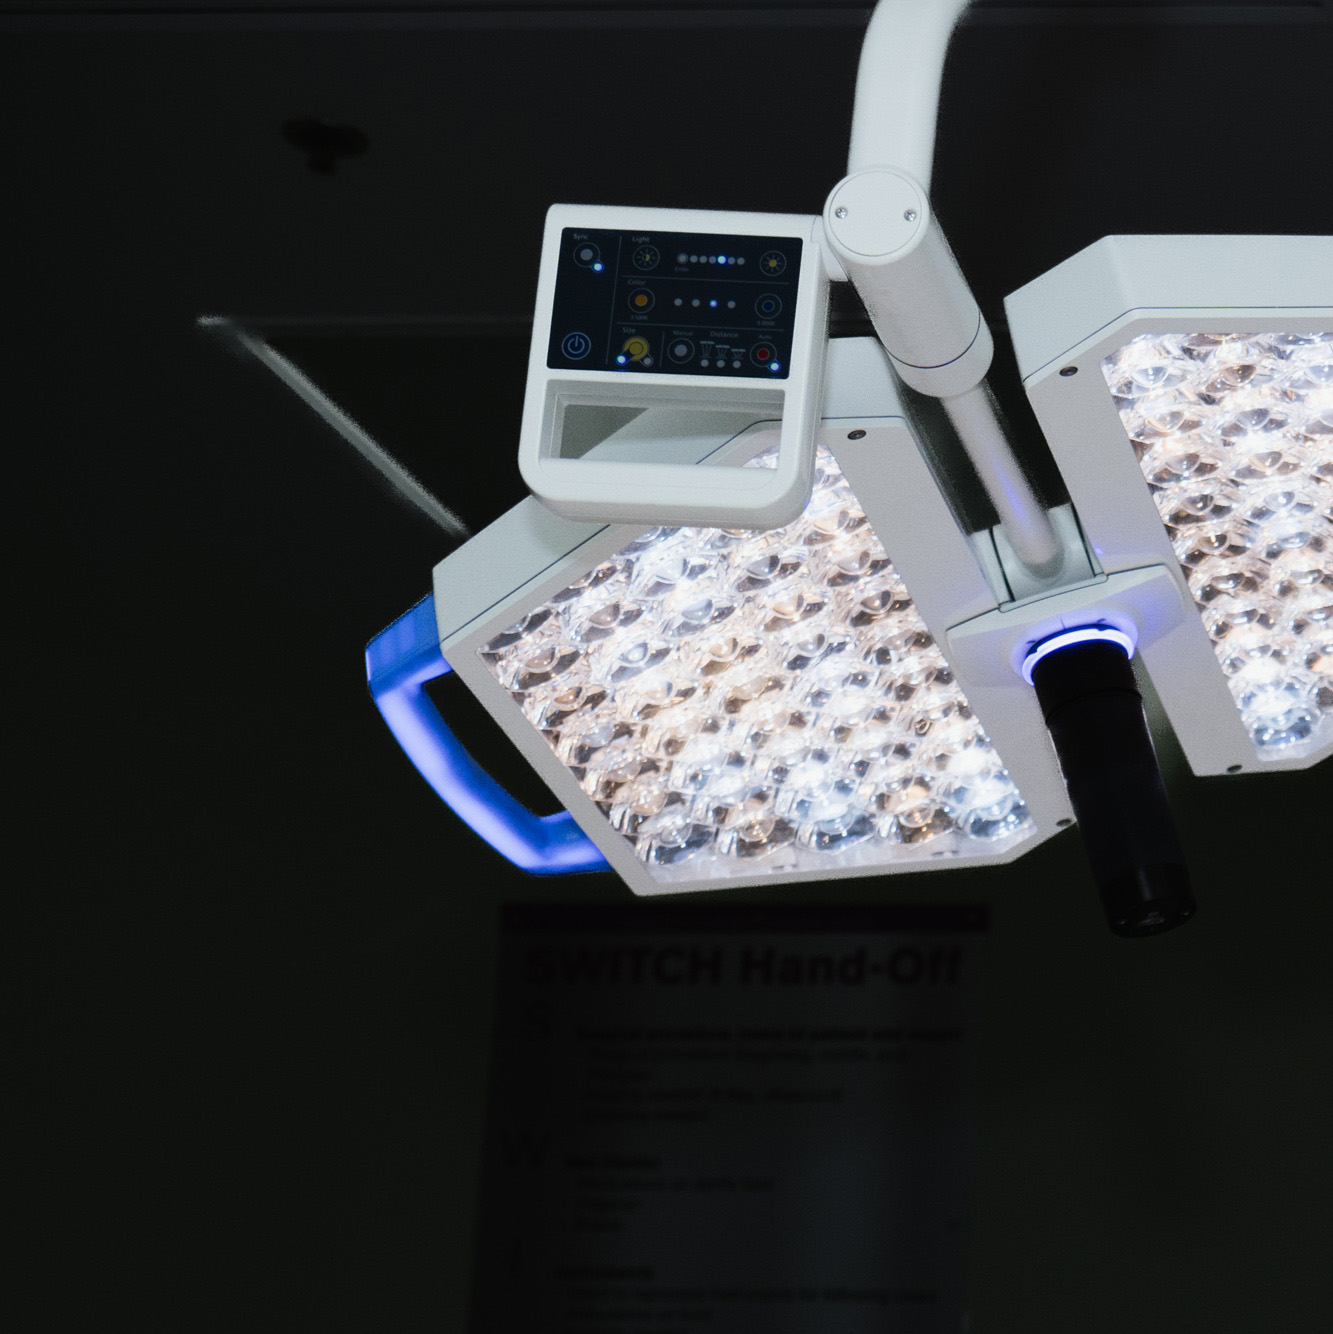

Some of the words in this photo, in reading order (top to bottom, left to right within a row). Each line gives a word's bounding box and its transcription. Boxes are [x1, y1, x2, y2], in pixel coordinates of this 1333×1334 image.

[573, 233, 589, 241] Sync
[710, 331, 739, 339] Distance
[522, 946, 722, 986] SWITCH
[739, 946, 963, 986] Hand-Off
